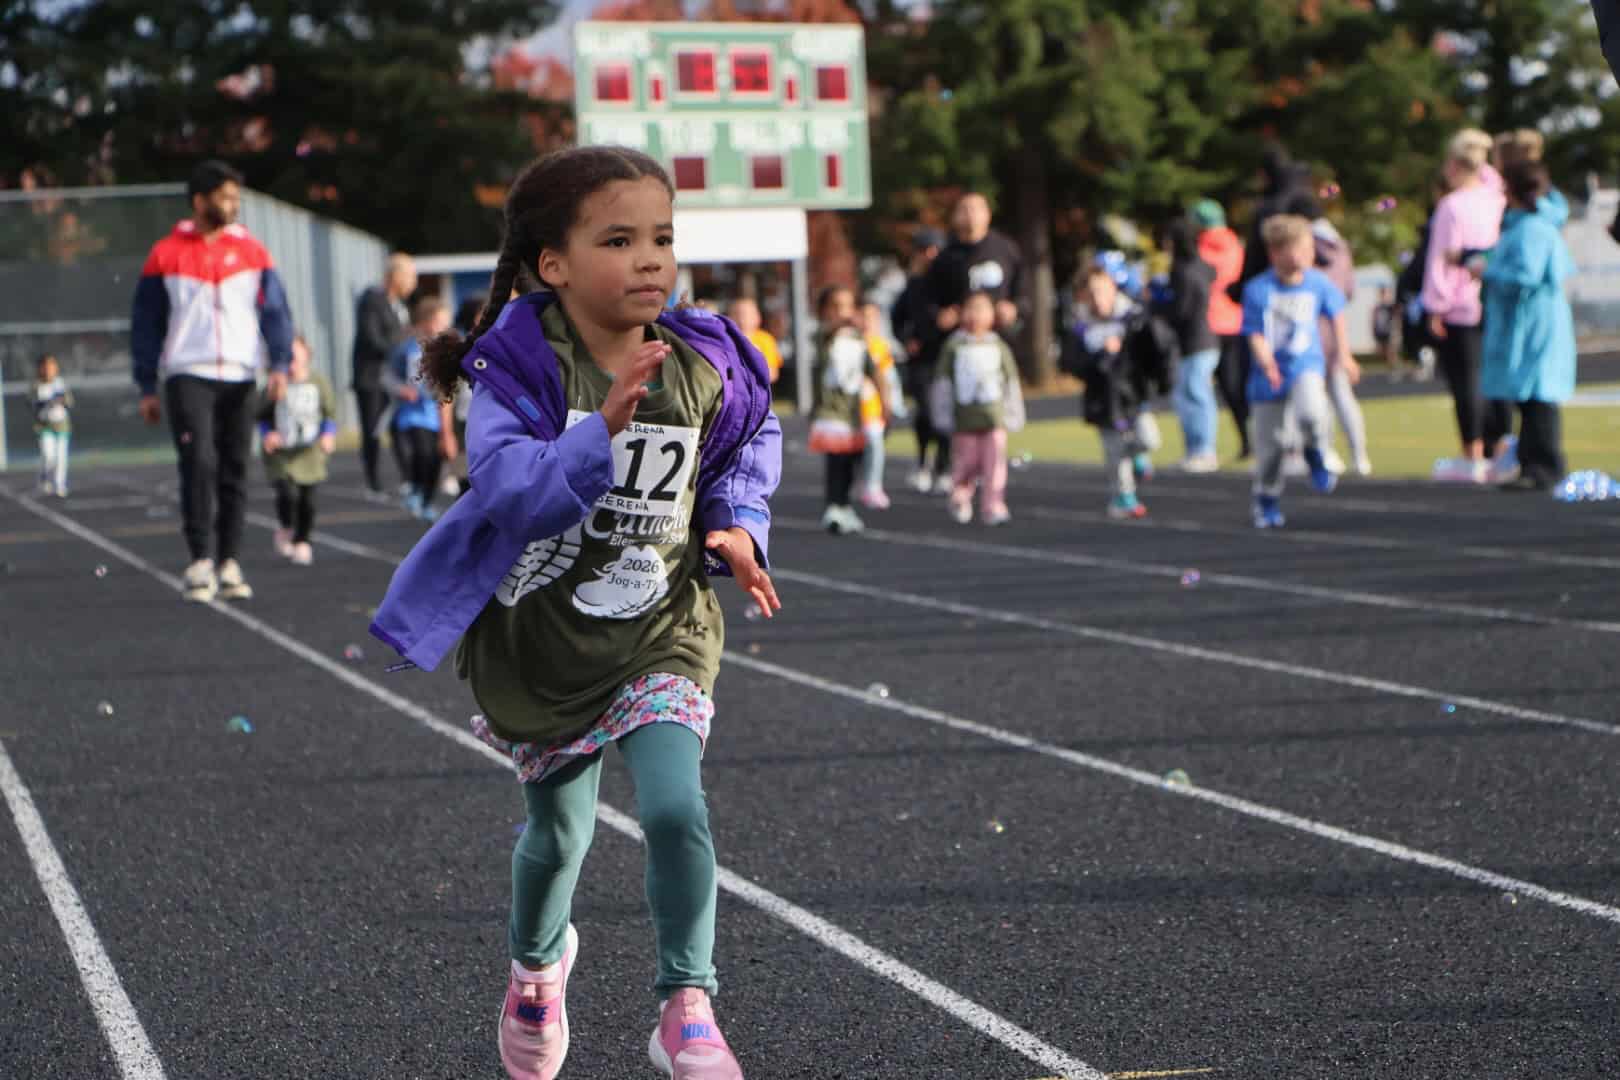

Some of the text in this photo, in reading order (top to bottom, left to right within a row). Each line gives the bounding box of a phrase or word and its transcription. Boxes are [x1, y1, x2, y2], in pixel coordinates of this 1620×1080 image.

[624, 423, 664, 434] ERENA
[609, 438, 685, 501] 12
[622, 558, 660, 573] 2026
[607, 573, 657, 590] Jog-a-T
